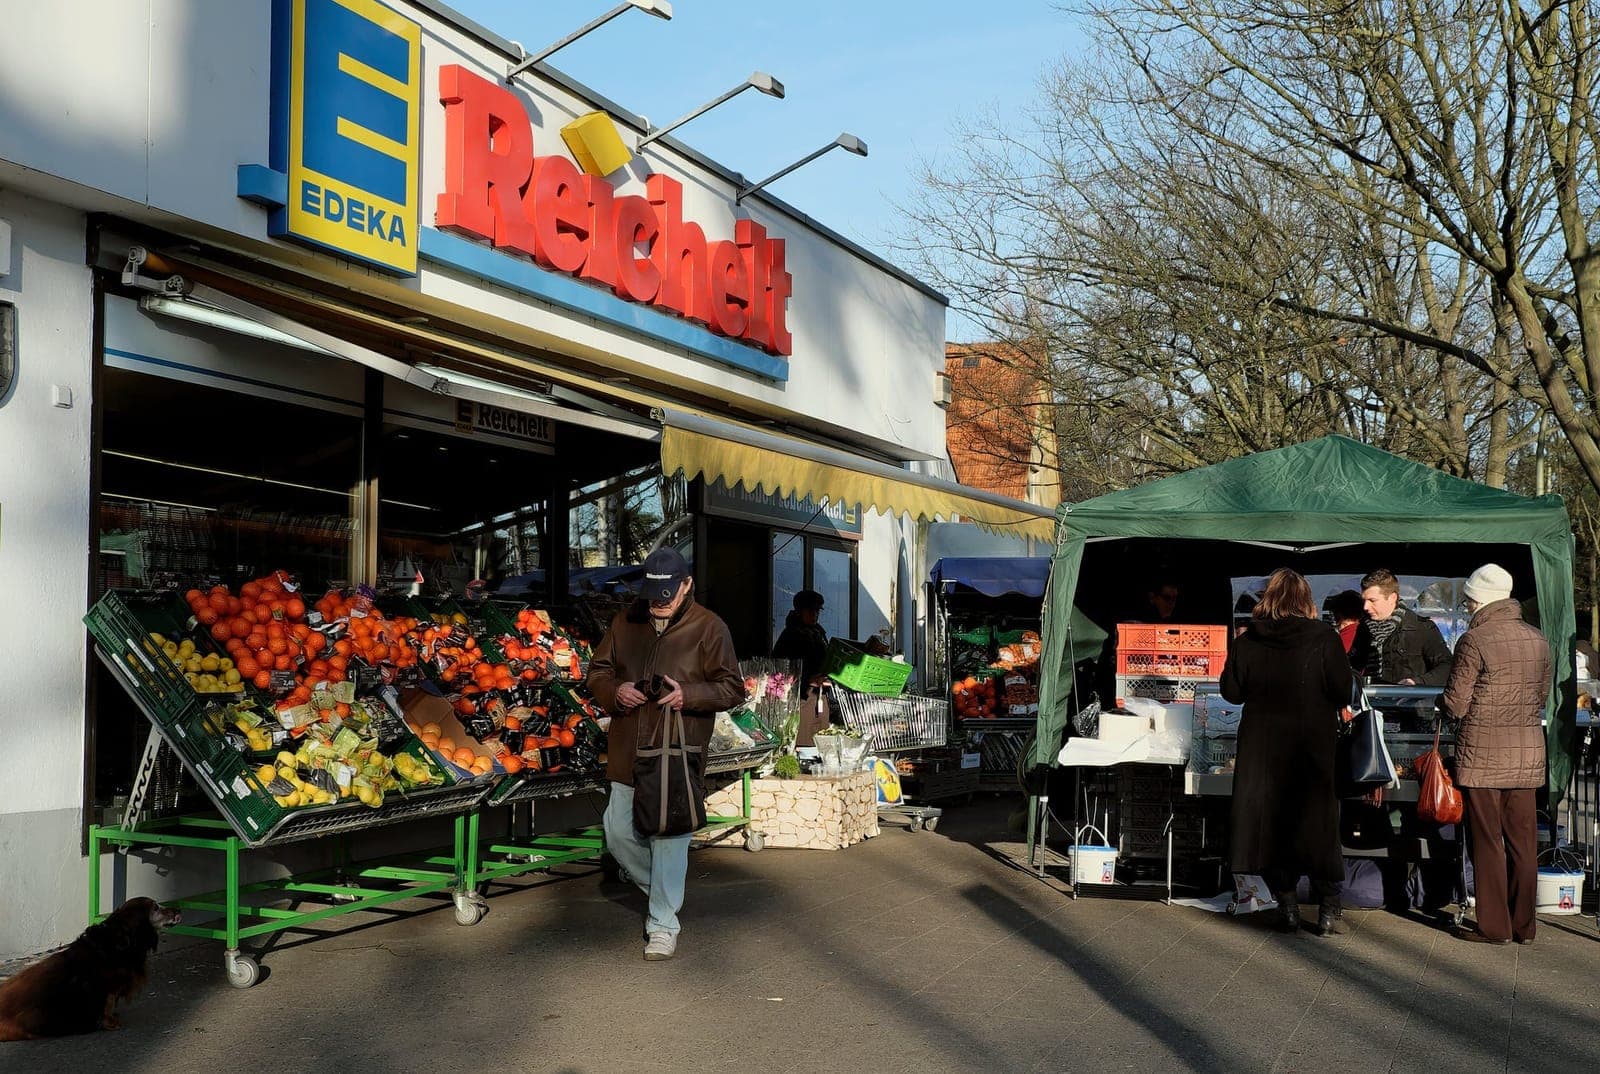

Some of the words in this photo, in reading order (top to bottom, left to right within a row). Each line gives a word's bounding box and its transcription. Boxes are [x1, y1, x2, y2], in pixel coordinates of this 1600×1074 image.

[301, 180, 407, 247] EDEKA
[434, 64, 793, 357] Reichelt
[478, 403, 549, 440] Reichelt
